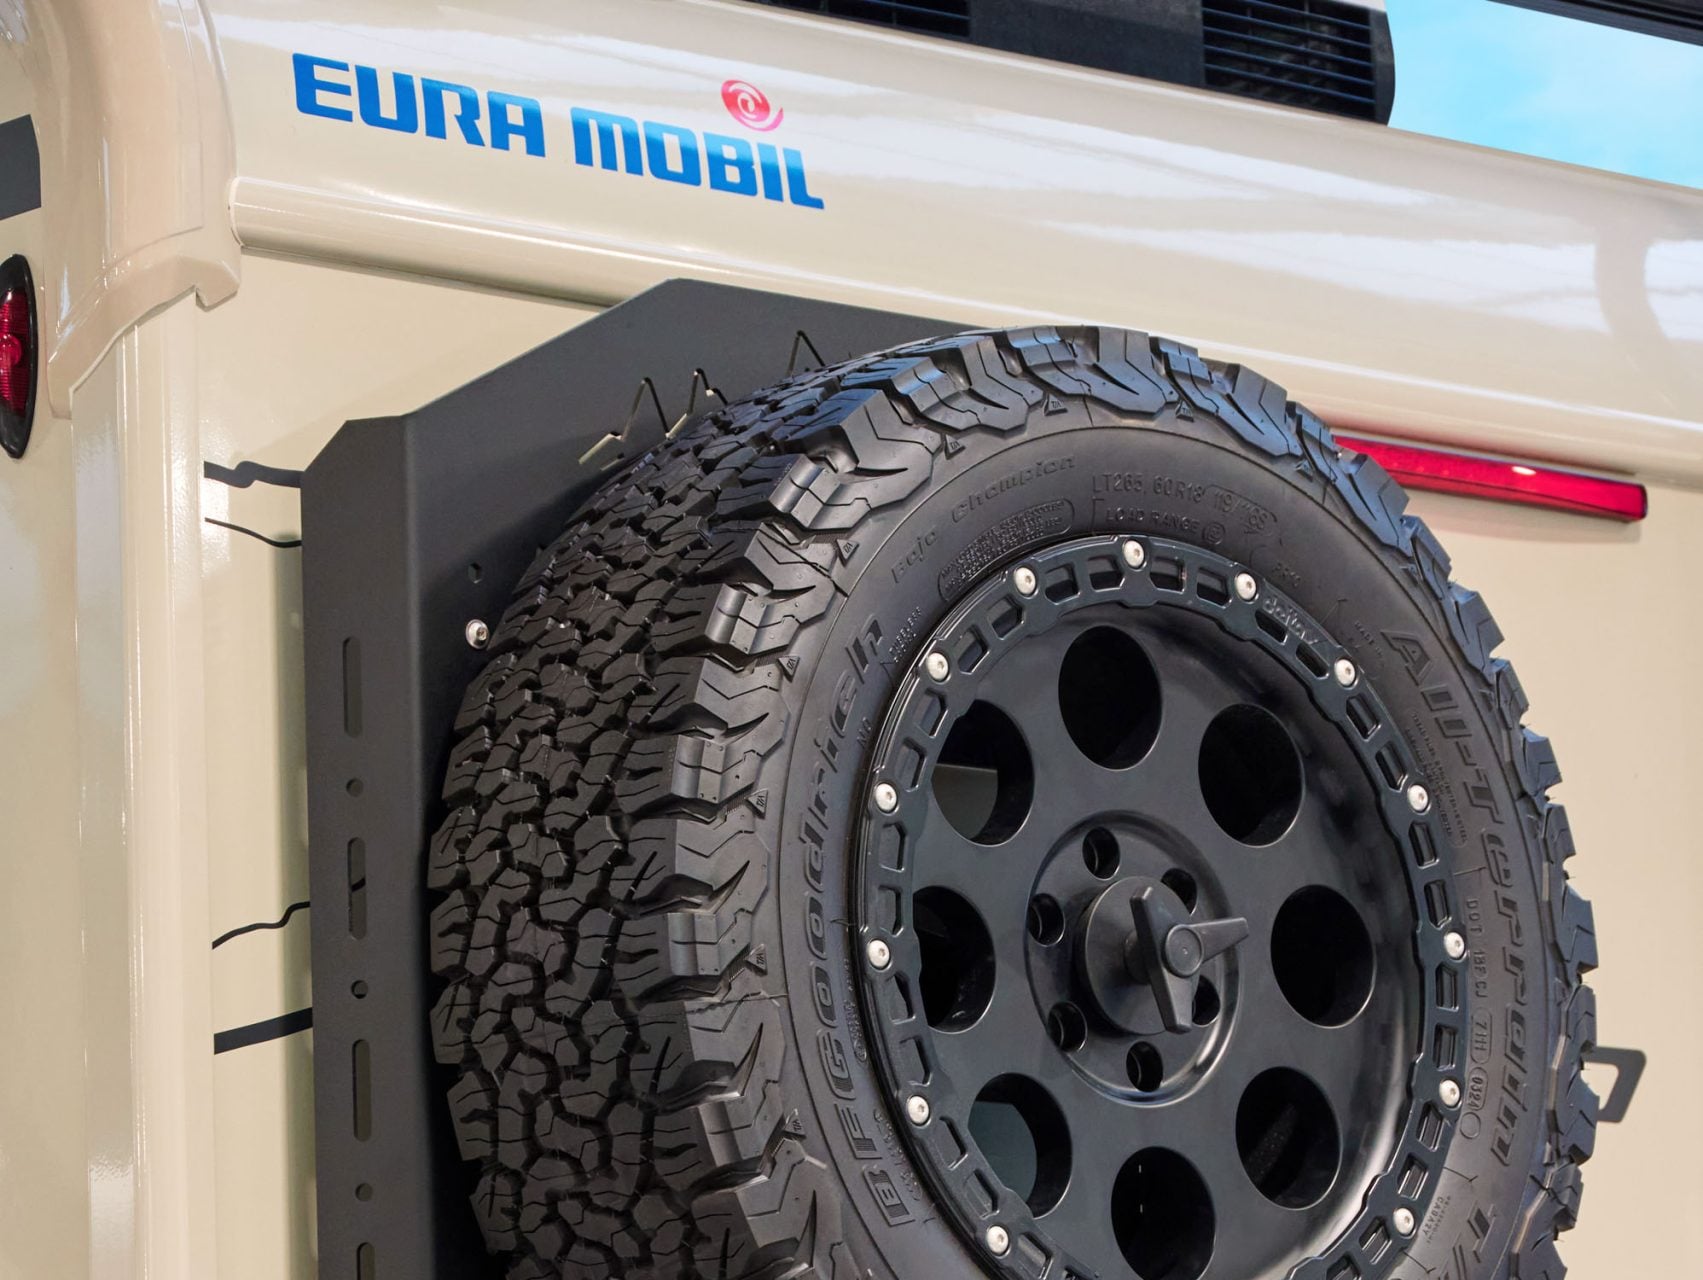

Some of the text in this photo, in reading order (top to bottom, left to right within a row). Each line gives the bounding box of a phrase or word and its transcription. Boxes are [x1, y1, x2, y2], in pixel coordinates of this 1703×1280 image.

[291, 53, 825, 210] EURA MOBIL
[1092, 472, 1204, 503] LT26560R18
[1151, 511, 1202, 534] RANGE
[798, 612, 916, 1227] BFGoodrich
[1380, 628, 1528, 1167] All-Terrain
[1466, 898, 1483, 933] DOT
